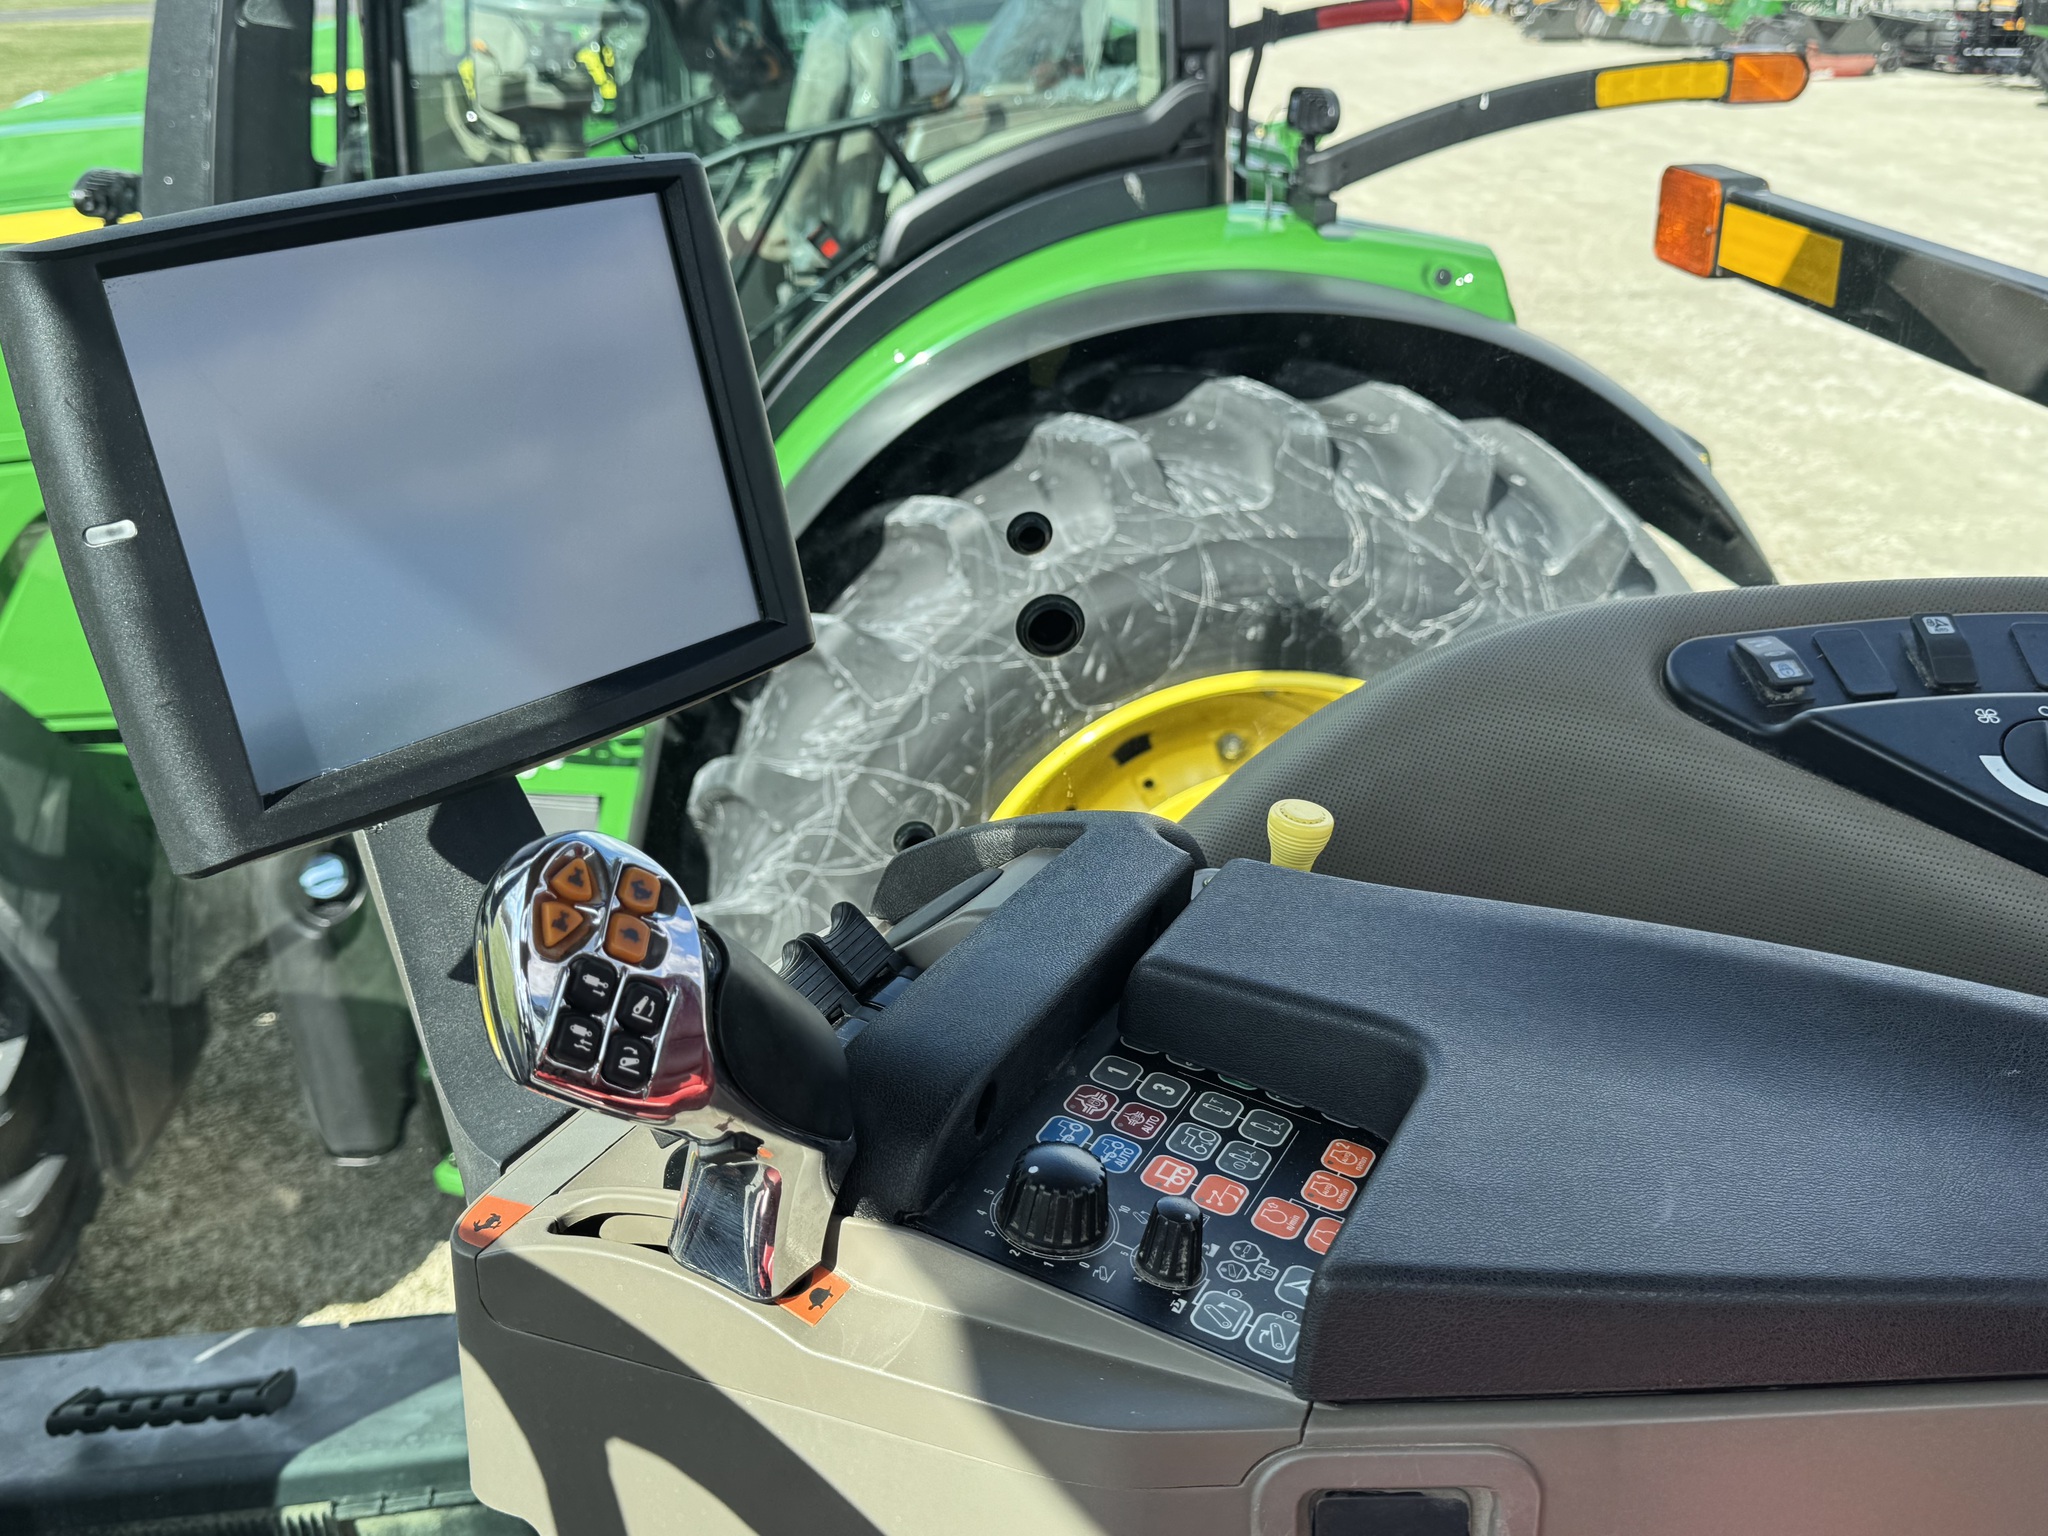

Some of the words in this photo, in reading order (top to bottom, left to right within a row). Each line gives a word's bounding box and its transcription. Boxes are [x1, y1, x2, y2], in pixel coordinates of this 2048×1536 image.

[1107, 1066, 1128, 1076] 1
[1152, 1083, 1176, 1096] 3
[1141, 1115, 1160, 1134] AUTO
[1335, 1142, 1351, 1150] 2
[1114, 1147, 1135, 1168] AUTO
[1119, 1205, 1131, 1214] 10
[1286, 1214, 1300, 1231] n/min
[984, 1229, 996, 1237] 3
[1009, 1248, 1021, 1257] 2
[1079, 1261, 1091, 1269] 0
